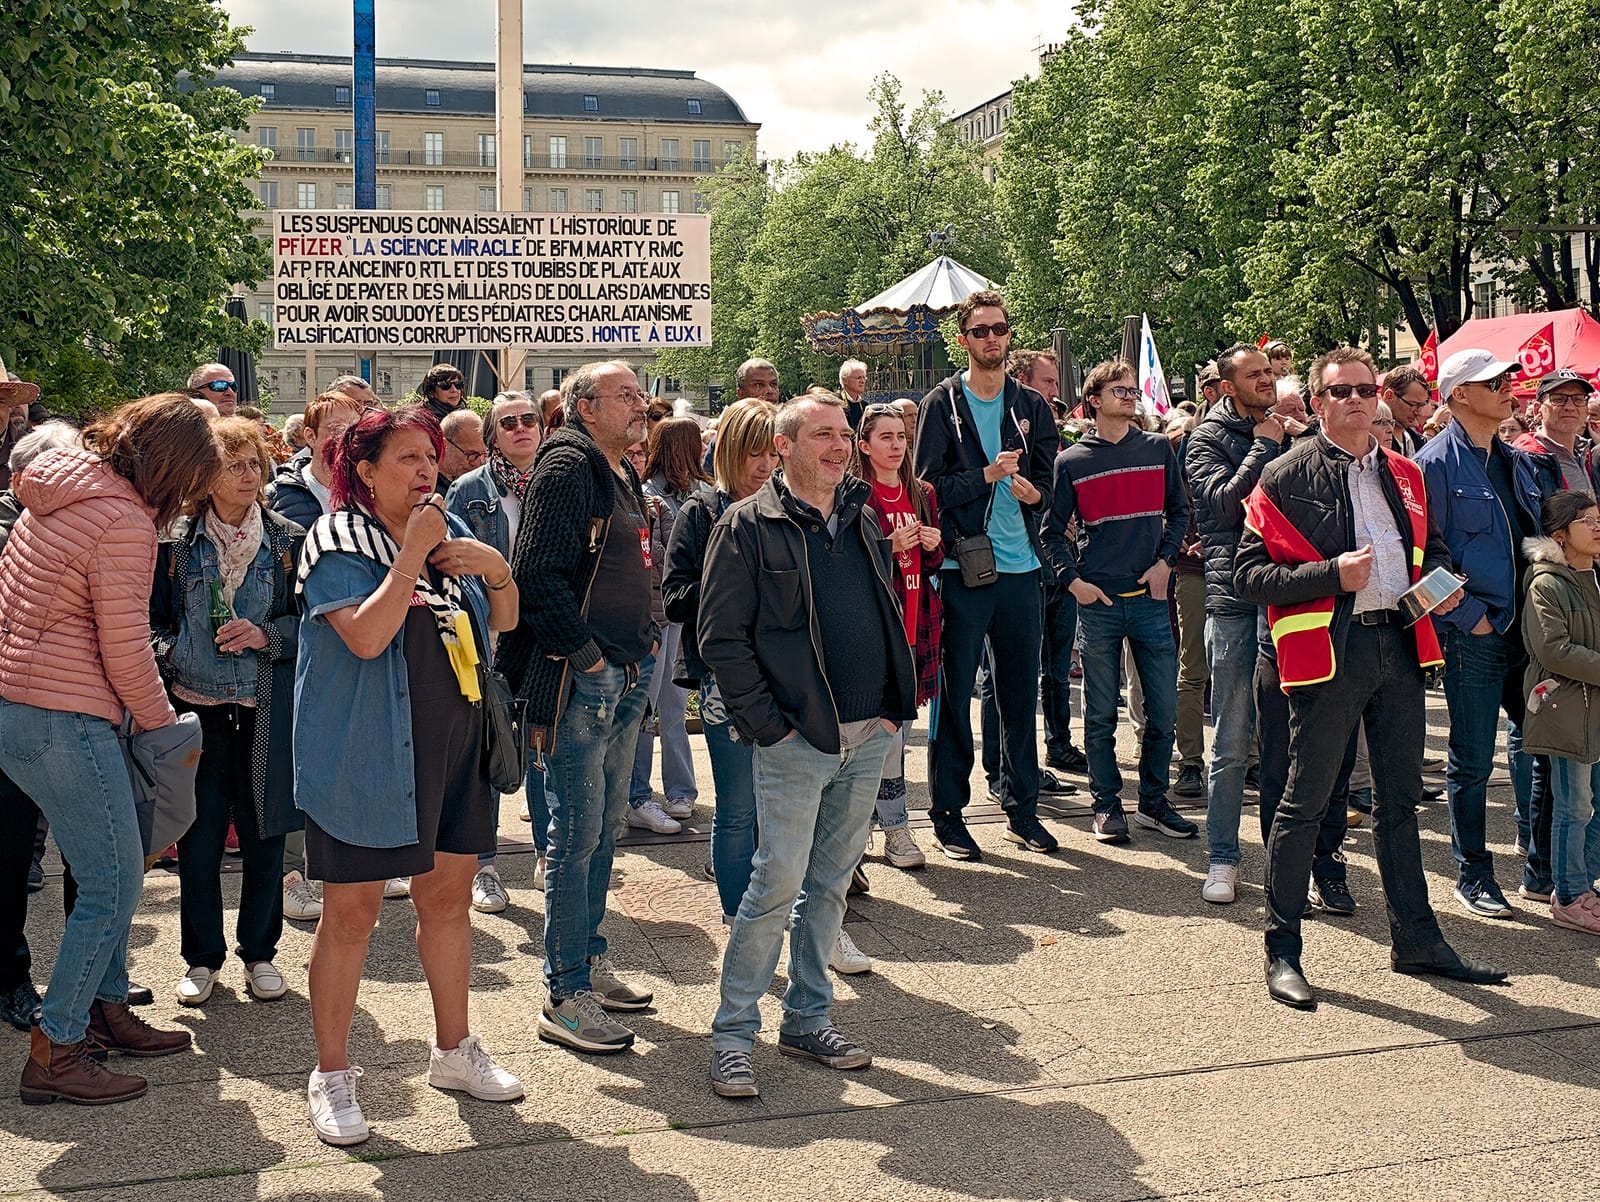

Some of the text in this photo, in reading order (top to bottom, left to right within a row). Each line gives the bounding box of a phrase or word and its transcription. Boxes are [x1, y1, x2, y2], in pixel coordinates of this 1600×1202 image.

[281, 215, 313, 233] LES
[315, 216, 413, 234] SUSPENDUS
[417, 214, 544, 235] CONNAISSAIENT
[657, 219, 677, 236] DE
[380, 235, 448, 256] SCIENCE
[526, 239, 546, 256] DE
[650, 240, 684, 258] RMC
[420, 261, 450, 278] RTL
[454, 261, 475, 278] ET
[477, 261, 508, 278] DES
[511, 258, 577, 278] TOUBIBS
[579, 262, 599, 278] DE
[277, 279, 333, 300] OBLIGÉ
[412, 282, 444, 300] DES
[447, 279, 532, 300] MILLIARDS
[535, 283, 555, 300] DE
[557, 283, 628, 300] DOLLARS
[276, 304, 320, 323] POUR
[324, 302, 369, 323] AVOIR
[372, 302, 445, 322] SOUDOYÉ
[448, 304, 479, 322] DES
[568, 302, 693, 322] CHARLATANISME
[592, 325, 641, 343] HONTE
[648, 322, 660, 342] À
